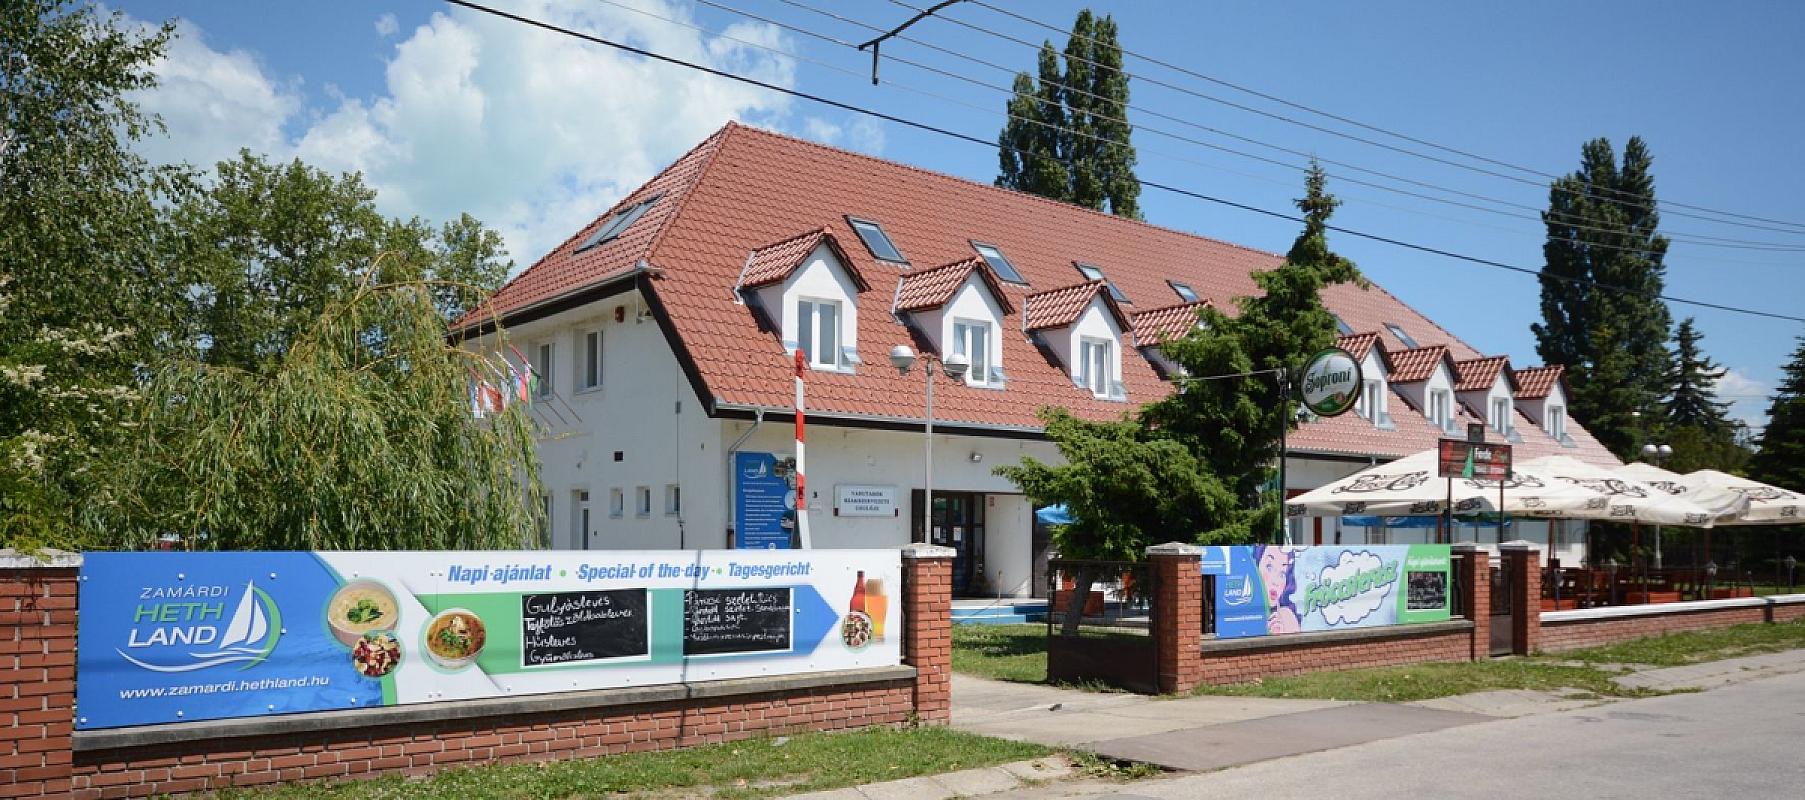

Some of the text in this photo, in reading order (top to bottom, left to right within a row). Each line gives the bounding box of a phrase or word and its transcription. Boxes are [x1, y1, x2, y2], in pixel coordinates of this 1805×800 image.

[1306, 367, 1352, 394] Soproni
[448, 564, 552, 585] Napi ajánlat
[578, 562, 710, 583] Special of the day
[728, 562, 810, 580] Tagesgericht
[140, 584, 230, 600] ZAMÁRDI
[134, 602, 224, 623] HETH
[128, 626, 218, 648] LAND
[120, 676, 329, 699] www.zamardi.hethland.hu
